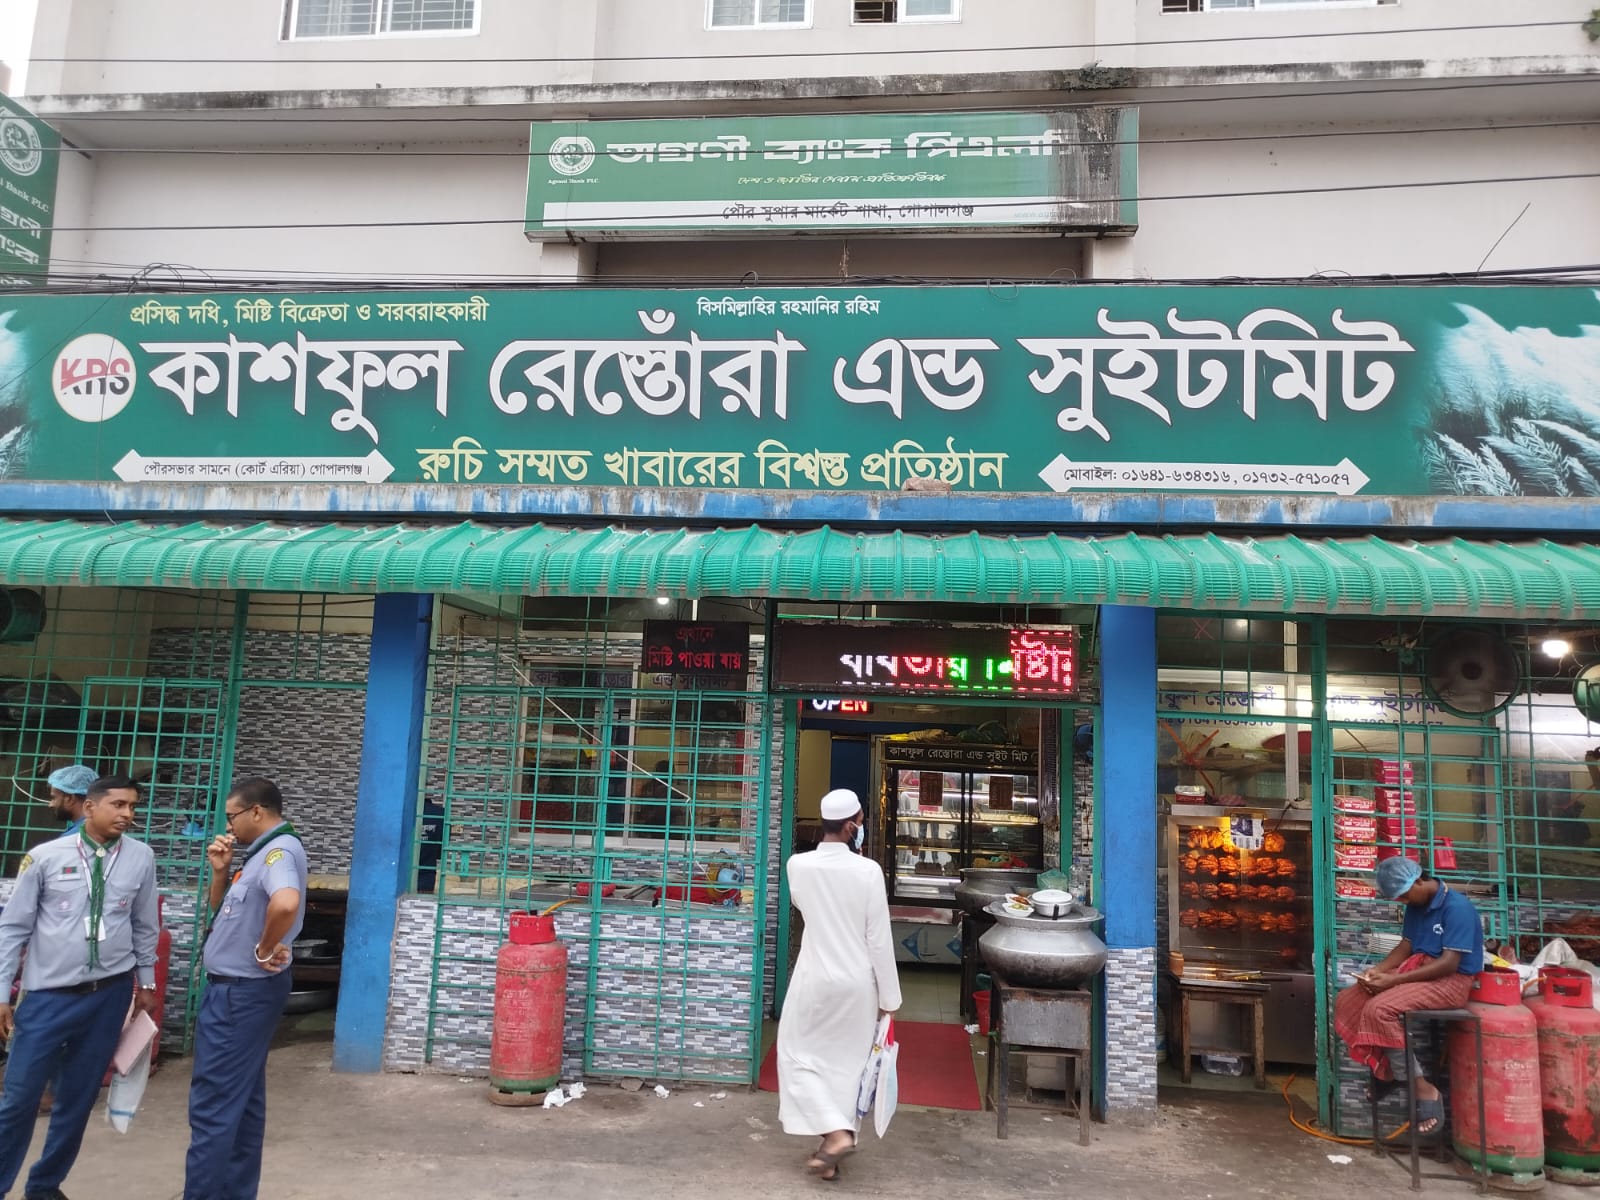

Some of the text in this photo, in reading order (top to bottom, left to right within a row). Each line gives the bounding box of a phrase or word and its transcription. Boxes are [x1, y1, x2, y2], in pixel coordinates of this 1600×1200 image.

[131, 296, 489, 327] প্রসিদ্ধ দধি, মিষ্টি বিক্রেতা ও সরবরাহকারী
[697, 296, 881, 317] বিসমিল্লাহির রহমানির রহিম
[61, 358, 130, 395] KRS
[138, 331, 465, 444] কাশফুল
[833, 338, 1000, 420] এন্ড
[1016, 307, 1416, 442] সুইটমিট
[144, 462, 195, 475] পৌরসভার
[199, 465, 231, 475] সামনে
[236, 462, 266, 475] (কোর্ট
[271, 462, 306, 475] এরিয়া)
[416, 436, 1009, 489] রুচি সম্মত খাবারের বিশ্বস্ত প্রতিষ্ঠান
[1243, 471, 1350, 486] ০১৭৩২-৫৭১০৫৭
[889, 746, 924, 758] কাশফুল
